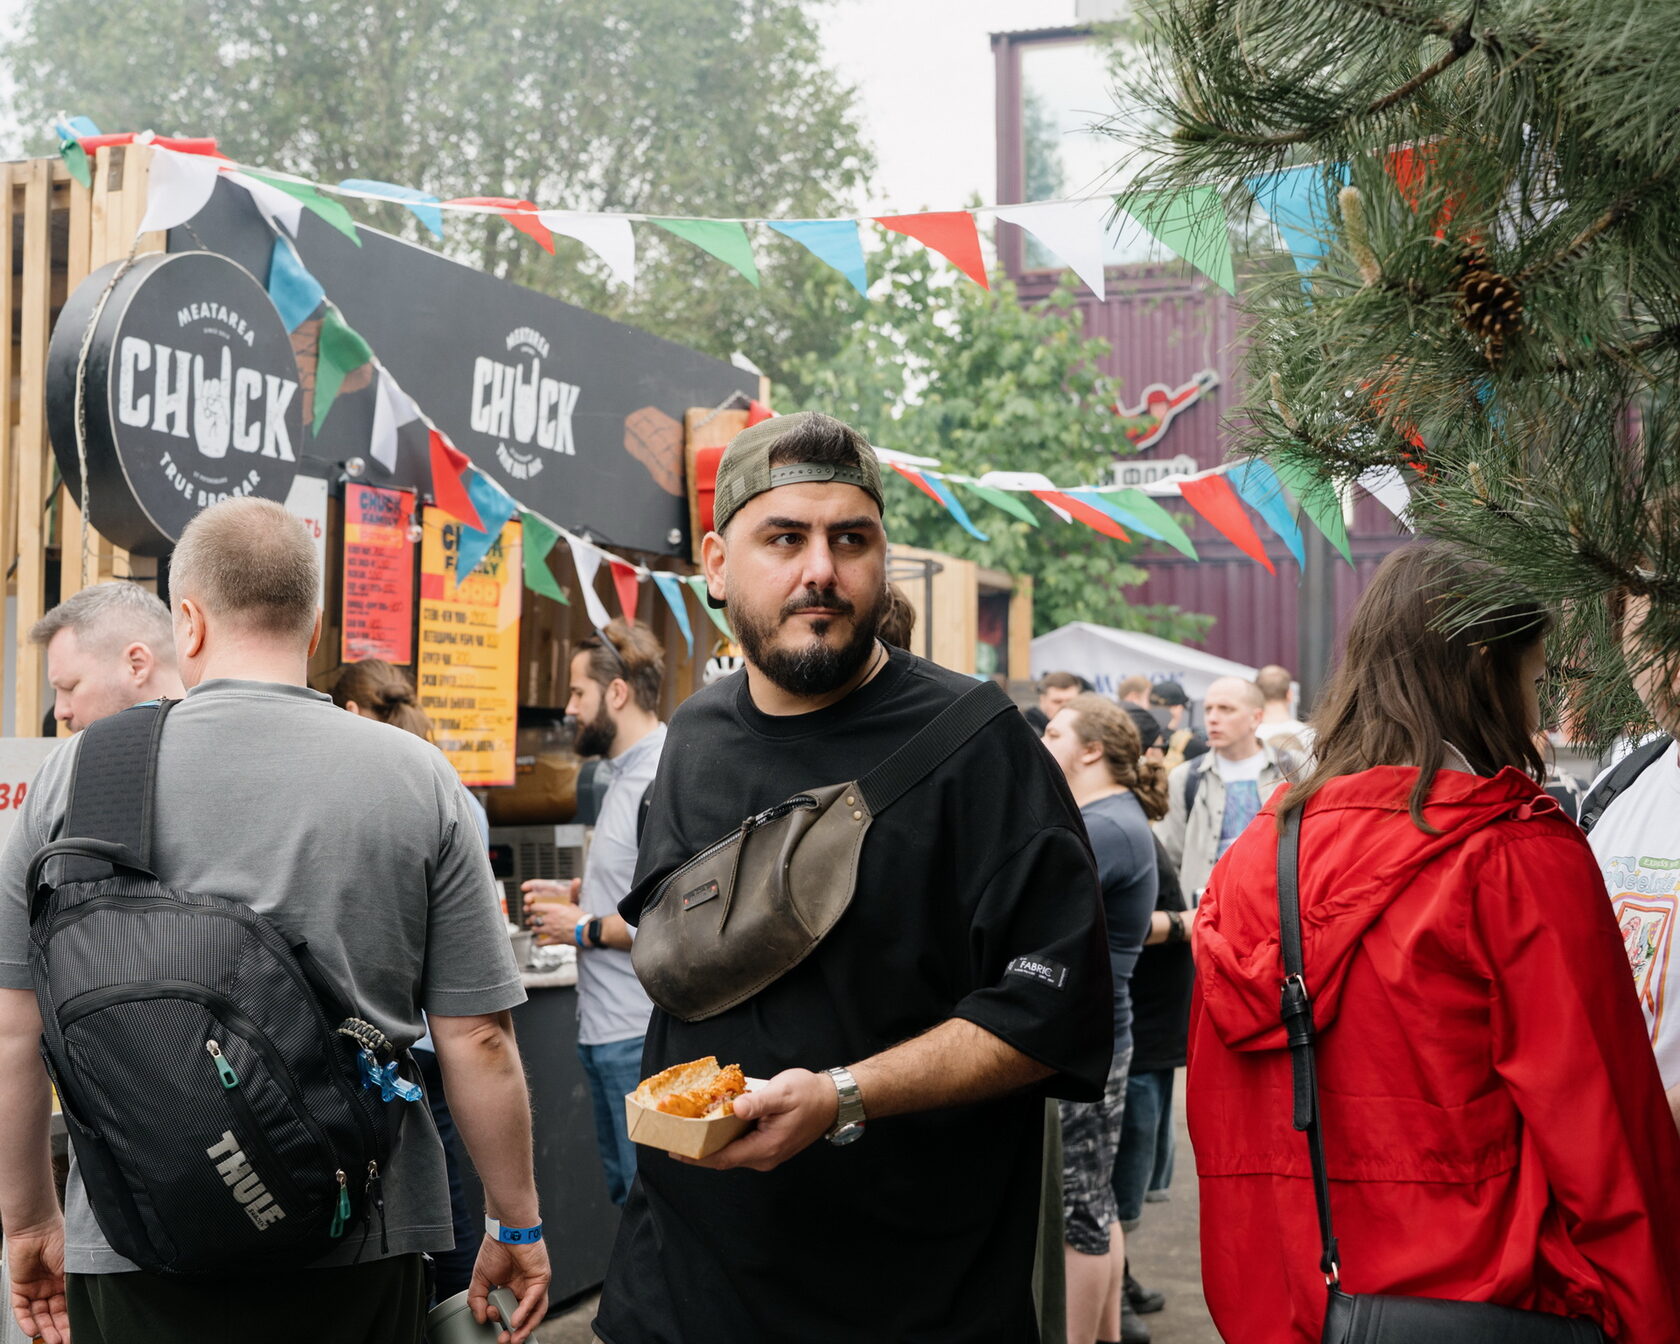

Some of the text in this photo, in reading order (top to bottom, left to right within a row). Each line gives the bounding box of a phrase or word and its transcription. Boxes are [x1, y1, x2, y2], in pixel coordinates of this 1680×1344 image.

[177, 302, 255, 347] MEATAREA
[119, 336, 298, 463] CHUCK
[470, 356, 581, 456] CHUCK
[159, 451, 194, 499] TRUE
[233, 469, 261, 498] BAR
[1020, 960, 1053, 977] FABRIC
[206, 1129, 287, 1232] THULE
